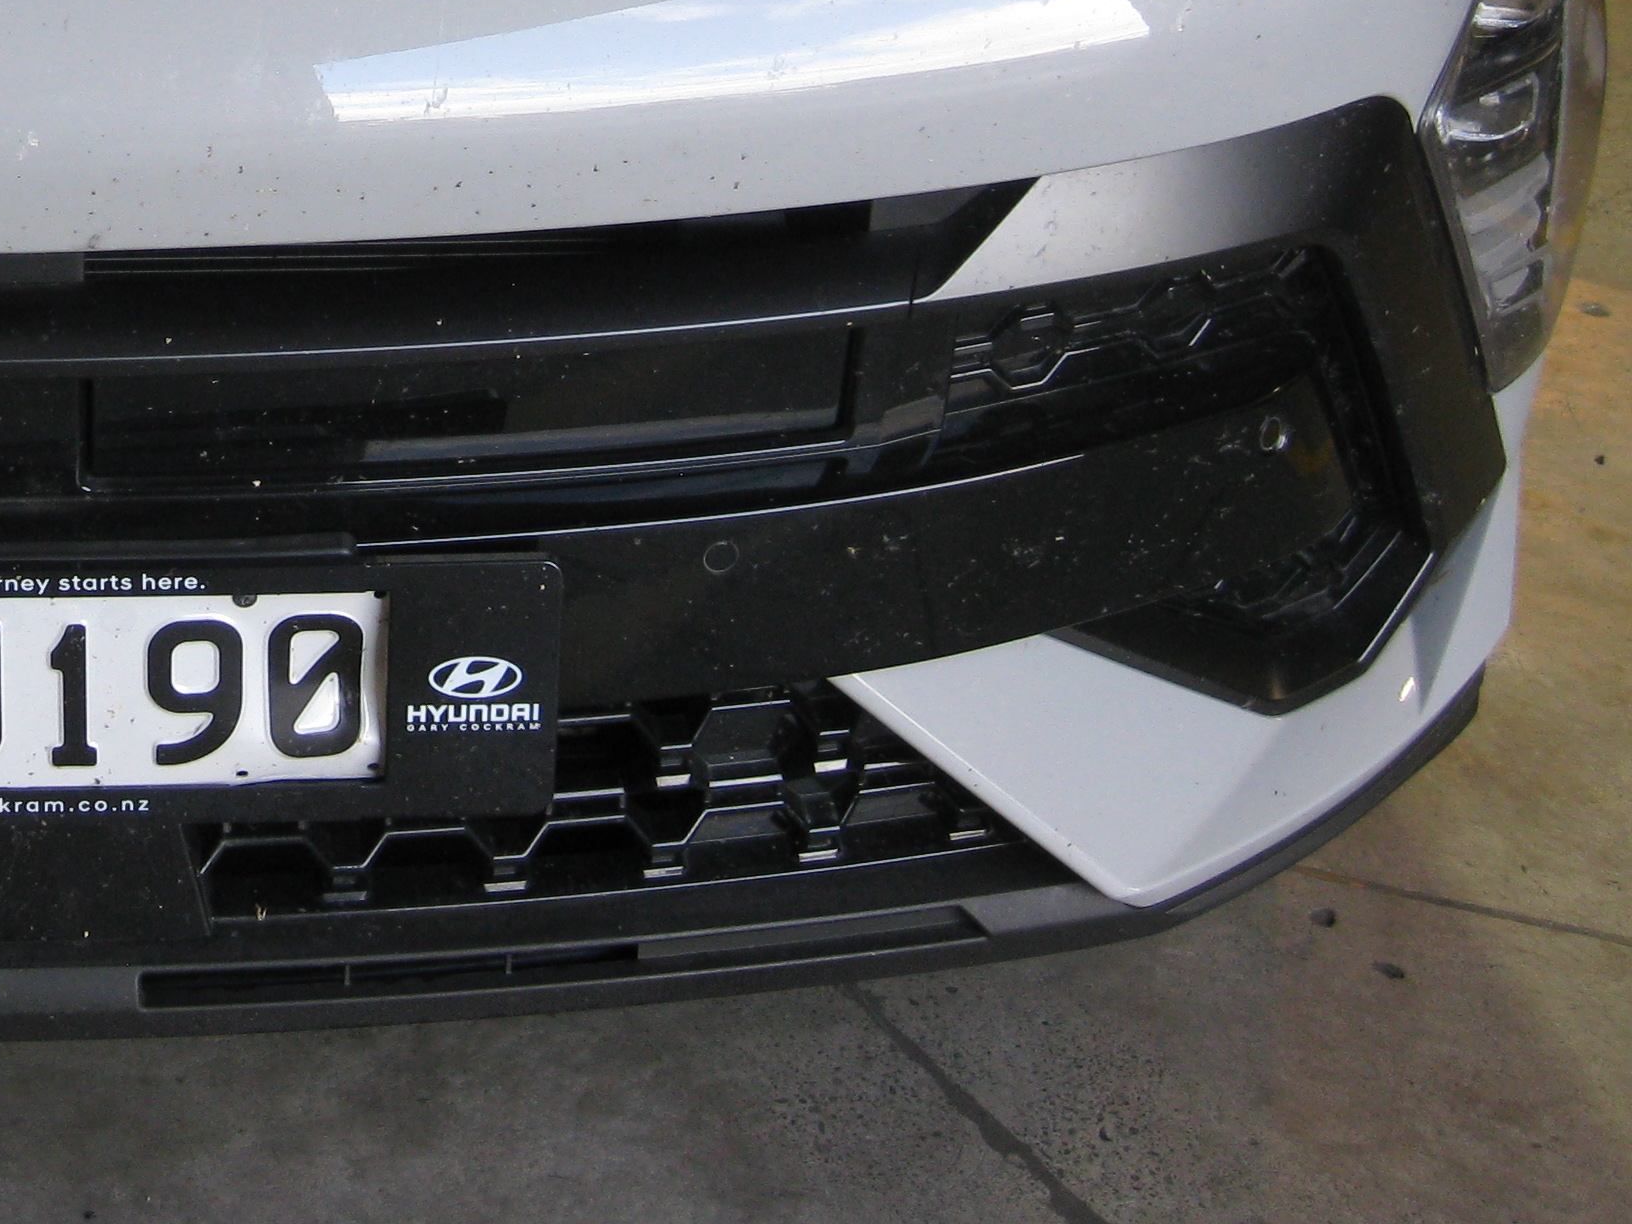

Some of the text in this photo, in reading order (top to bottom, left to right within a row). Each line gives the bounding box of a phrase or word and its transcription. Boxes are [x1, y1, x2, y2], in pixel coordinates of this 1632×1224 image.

[58, 574, 132, 591] starts
[141, 573, 206, 591] here.
[407, 703, 540, 723] HYUNDAI
[406, 723, 542, 732] GARY COCKRAM
